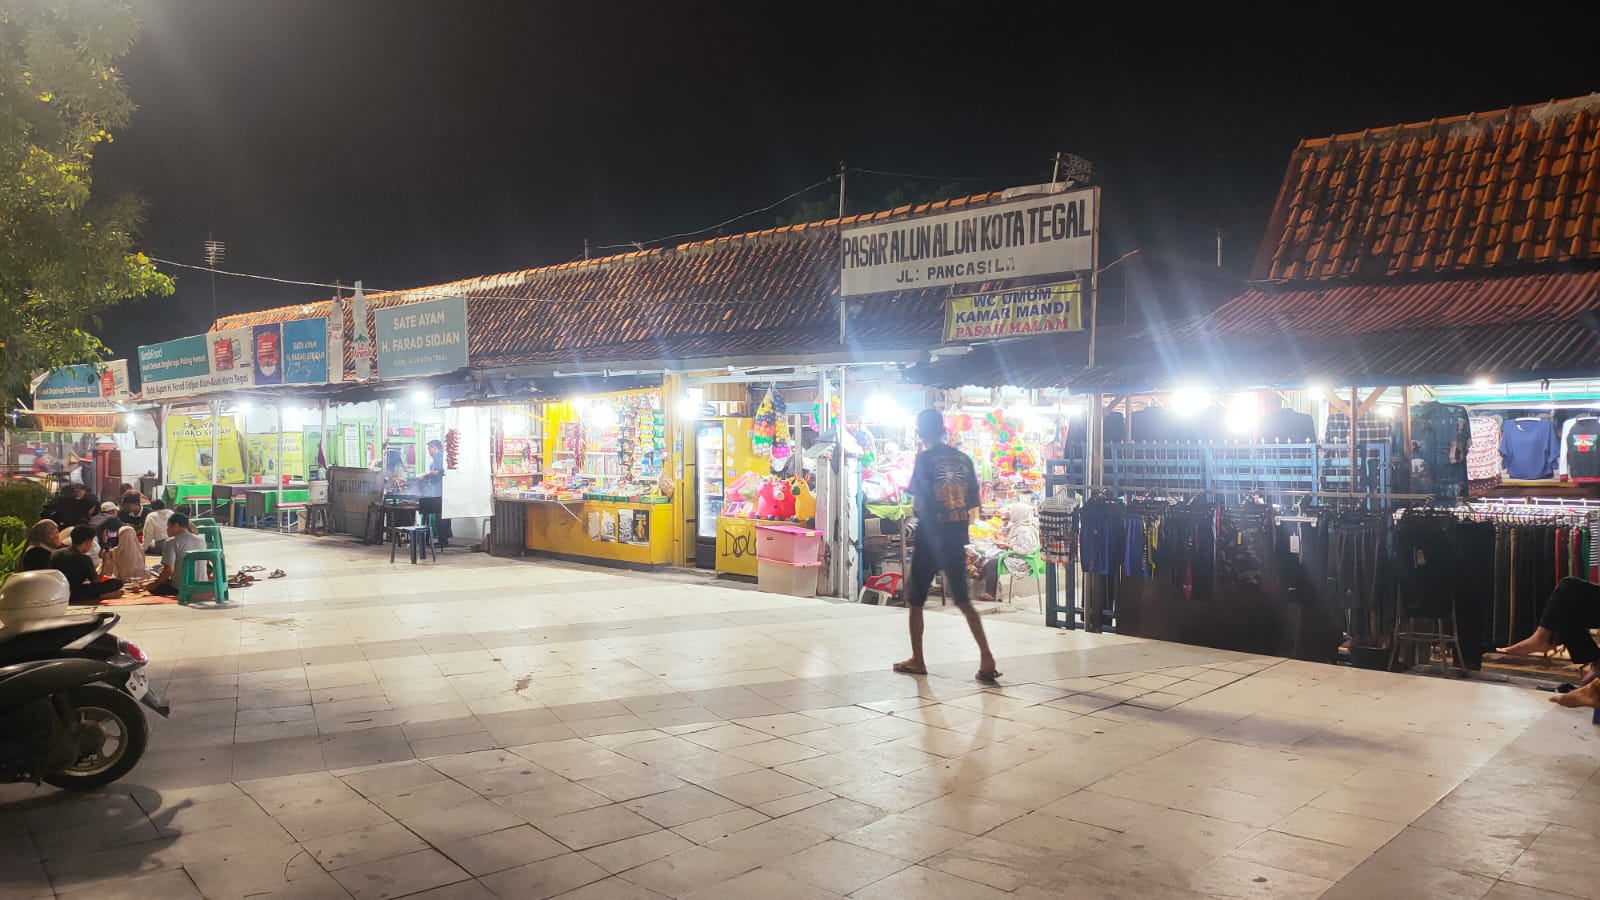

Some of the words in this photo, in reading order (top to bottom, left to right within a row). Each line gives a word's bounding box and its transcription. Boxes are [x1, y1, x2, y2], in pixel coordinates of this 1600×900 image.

[841, 232, 889, 270] PASAR
[890, 224, 932, 264] ALUN
[932, 217, 977, 258] ALUN
[980, 209, 1025, 252] KOTA
[1027, 198, 1091, 245] TEGAL
[973, 294, 997, 308] WC
[1002, 287, 1052, 305] UMUM
[393, 315, 417, 331] SATE
[418, 310, 446, 326] AYAM
[955, 307, 1011, 324] KAMAR
[1016, 300, 1070, 318] MANDI
[955, 322, 1005, 338] PASAR
[1008, 317, 1069, 334] MALAM
[381, 341, 391, 354] H.
[392, 336, 424, 352] FARAD
[425, 330, 460, 348] SIDJAN
[142, 348, 162, 361] GrabFood
[233, 372, 249, 385] Tegal
